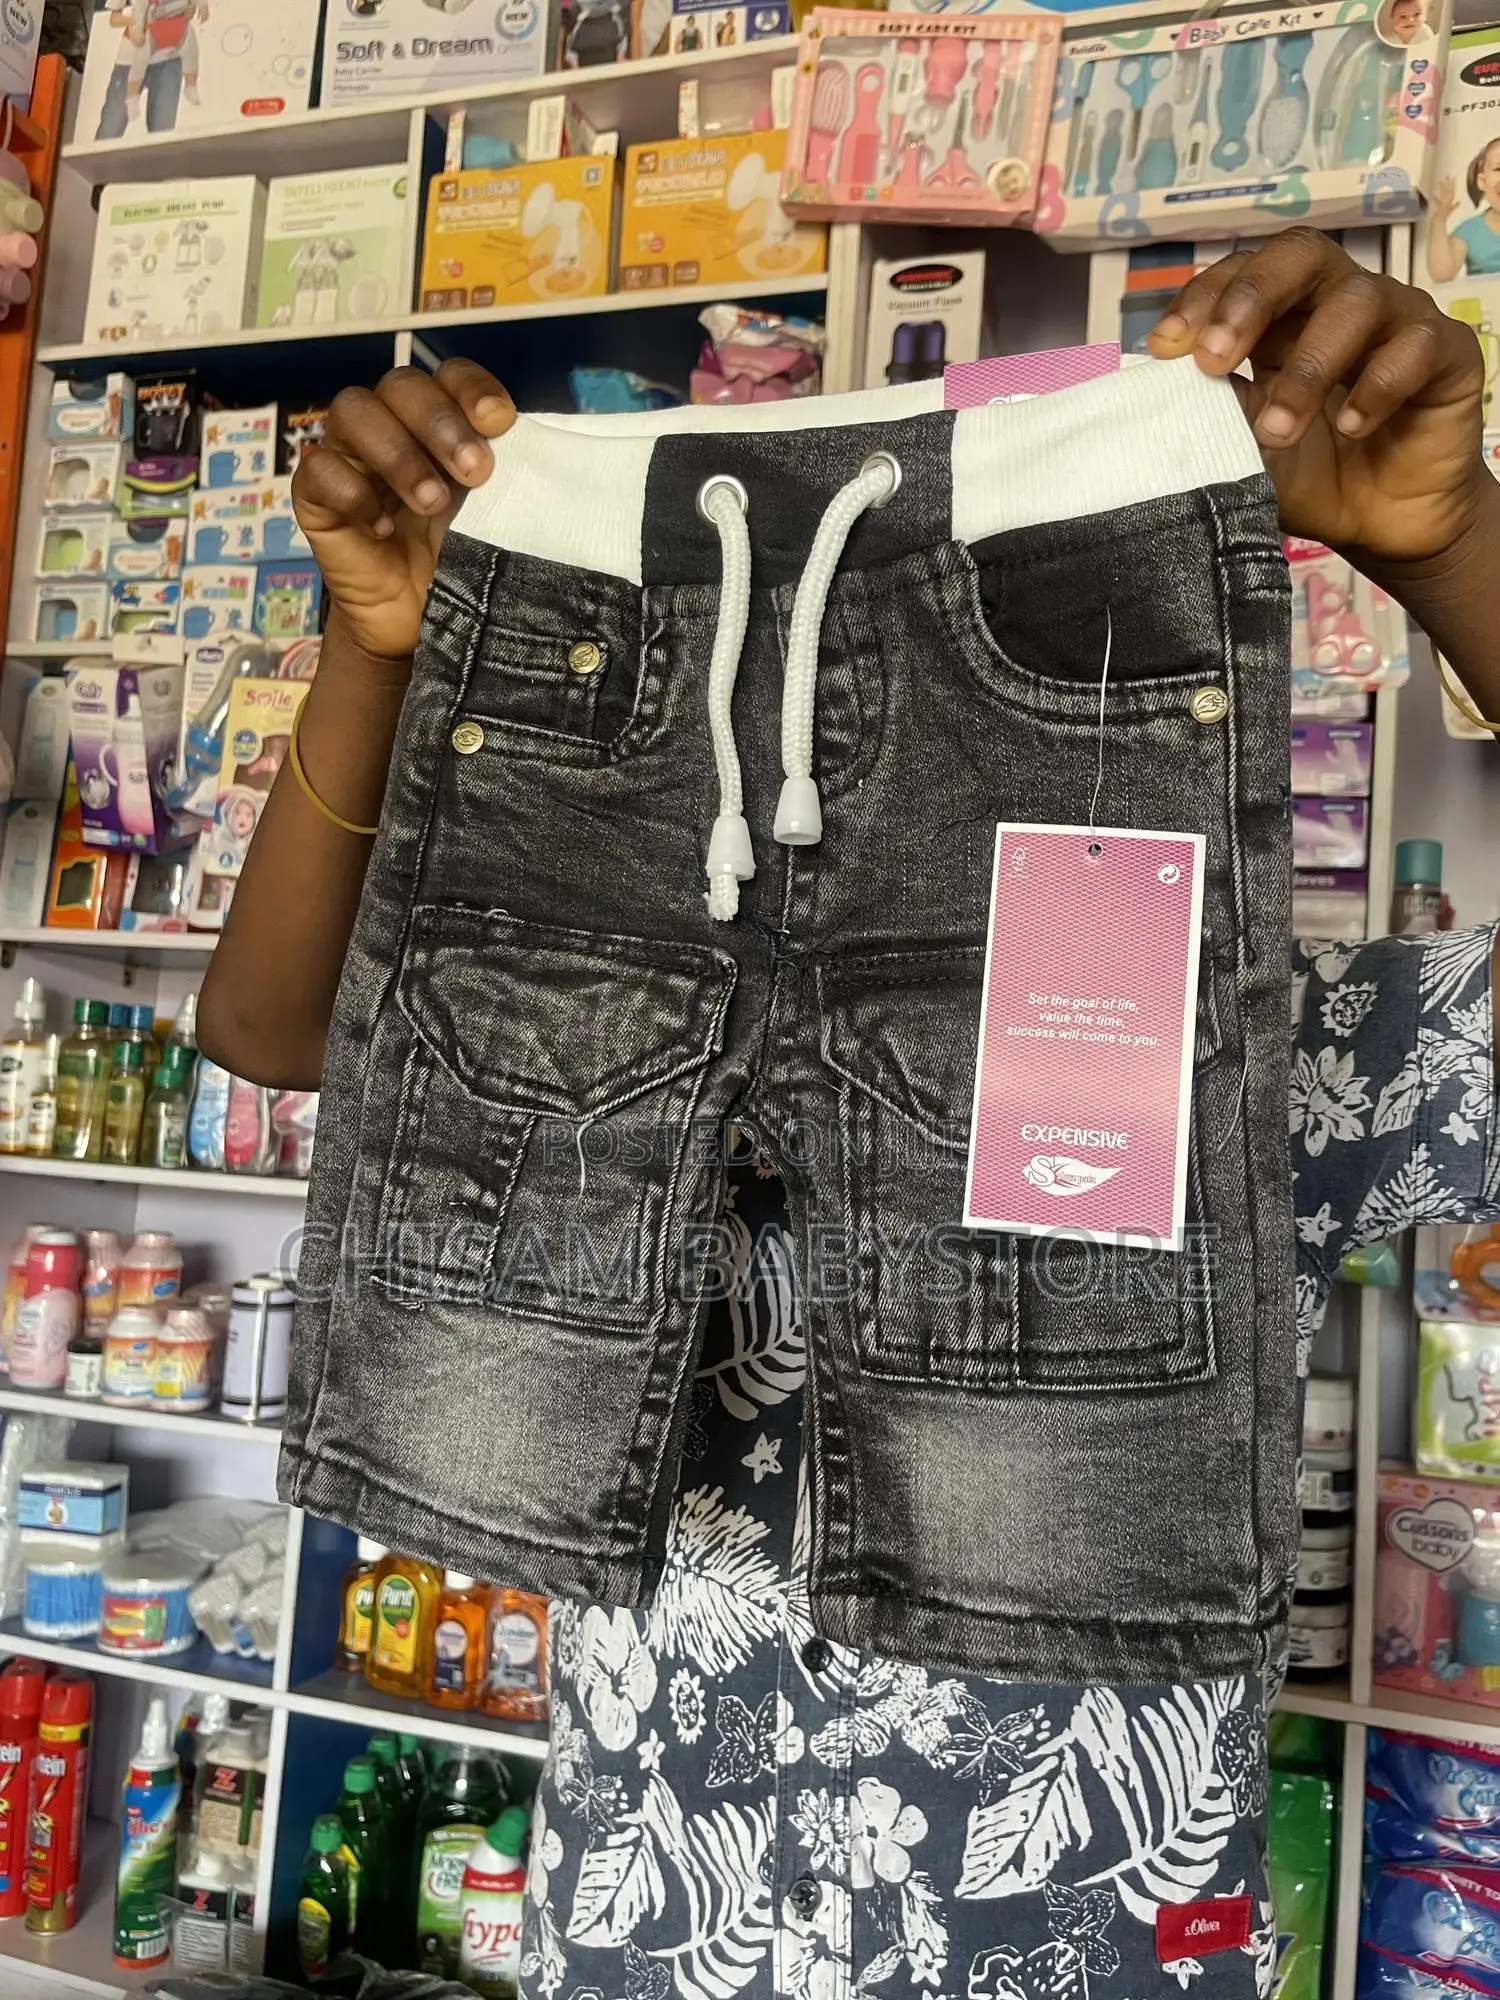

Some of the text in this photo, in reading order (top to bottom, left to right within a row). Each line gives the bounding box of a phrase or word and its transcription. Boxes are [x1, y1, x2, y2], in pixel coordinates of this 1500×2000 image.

[1188, 13, 1302, 44] Baby Care Kit
[336, 40, 385, 62] Soft
[411, 38, 494, 58] Dream
[1028, 992, 1048, 1005] Set
[1050, 994, 1070, 1007] the
[1072, 996, 1101, 1010] goal
[1102, 998, 1117, 1010] of
[1039, 1011, 1071, 1023] value
[1074, 1013, 1093, 1025] the
[1007, 1026, 1056, 1039] success
[1058, 1028, 1081, 1041] will
[1082, 1031, 1116, 1044] come
[1118, 1033, 1132, 1044] to
[1021, 1123, 1130, 1150] EXPENSIVE
[1395, 1516, 1469, 1543] Cussons
[1411, 1537, 1460, 1562] baby
[1183, 1917, 1221, 1937] s.Oliver
